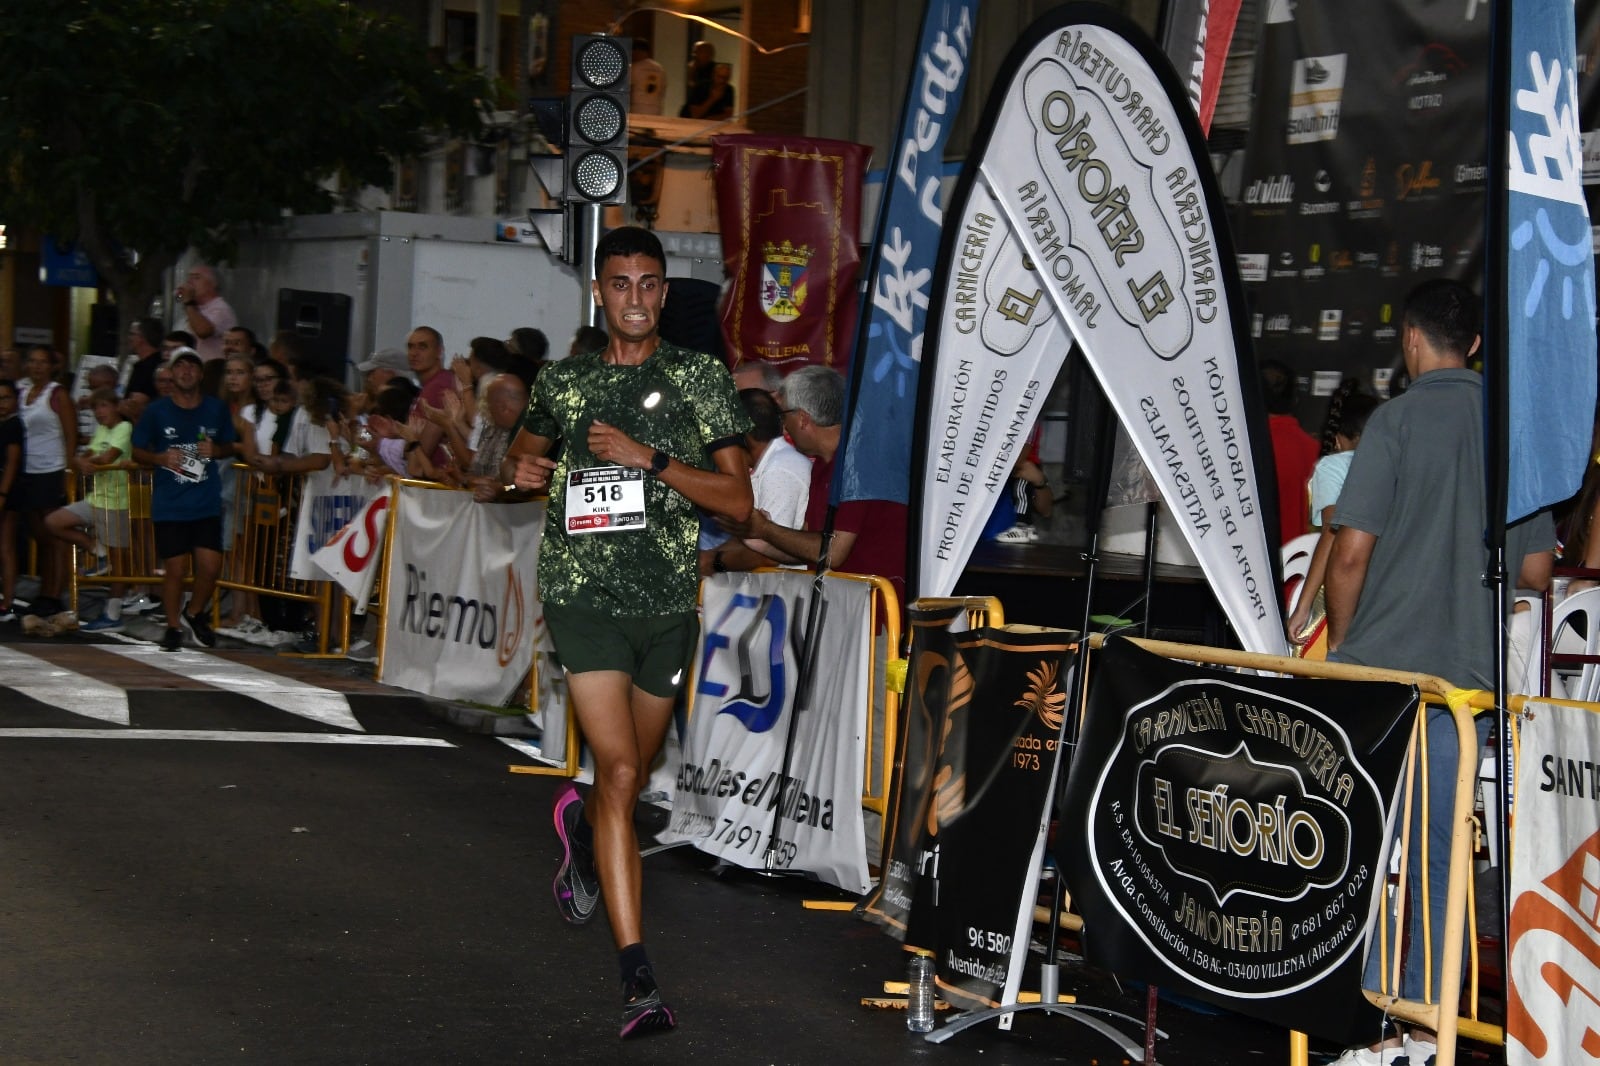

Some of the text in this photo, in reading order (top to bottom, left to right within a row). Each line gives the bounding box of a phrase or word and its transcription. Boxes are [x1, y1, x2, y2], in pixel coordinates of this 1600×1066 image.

[954, 211, 996, 335] CARNICERÍA
[996, 286, 1043, 327] EL
[752, 343, 811, 359] VILLENA
[935, 358, 973, 485] ELABORACIÓN
[984, 379, 1041, 495] ARTESANALES
[583, 484, 624, 504] 518
[936, 368, 1009, 562] PROPIA DE EMBUTIDOS
[1013, 752, 1040, 771] 1973
[1133, 691, 1355, 808] CARNICERÍA CHARCUTERÍA
[1154, 777, 1325, 869] EL SEÑORÍO
[1174, 891, 1284, 953] JAMONERÍA
[1302, 864, 1368, 936] 681 667 028
[948, 948, 985, 979] Avenida
[968, 927, 985, 949] 96
[1261, 953, 1306, 980] VILLENA
[1307, 913, 1358, 968] (Alicante)
